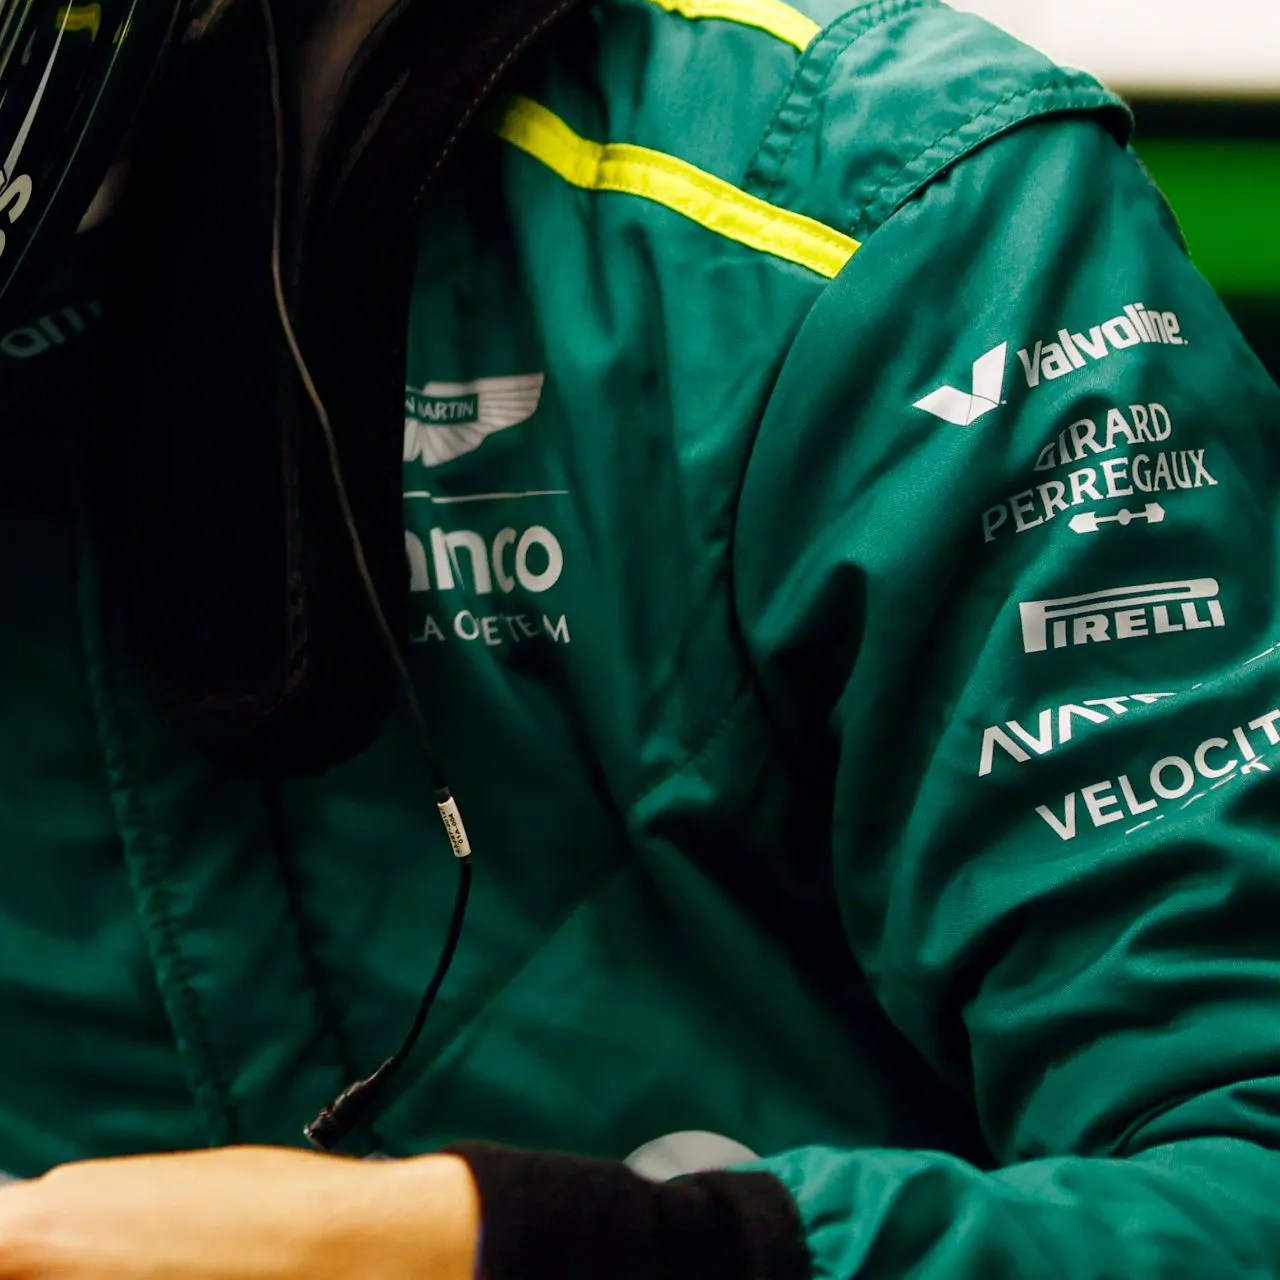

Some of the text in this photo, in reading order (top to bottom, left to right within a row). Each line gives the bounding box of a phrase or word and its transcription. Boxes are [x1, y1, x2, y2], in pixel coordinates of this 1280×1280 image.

[1032, 403, 1172, 472] GIRARD
[981, 448, 1219, 544] PERREGAUX
[1018, 577, 1226, 654] PIRELLI
